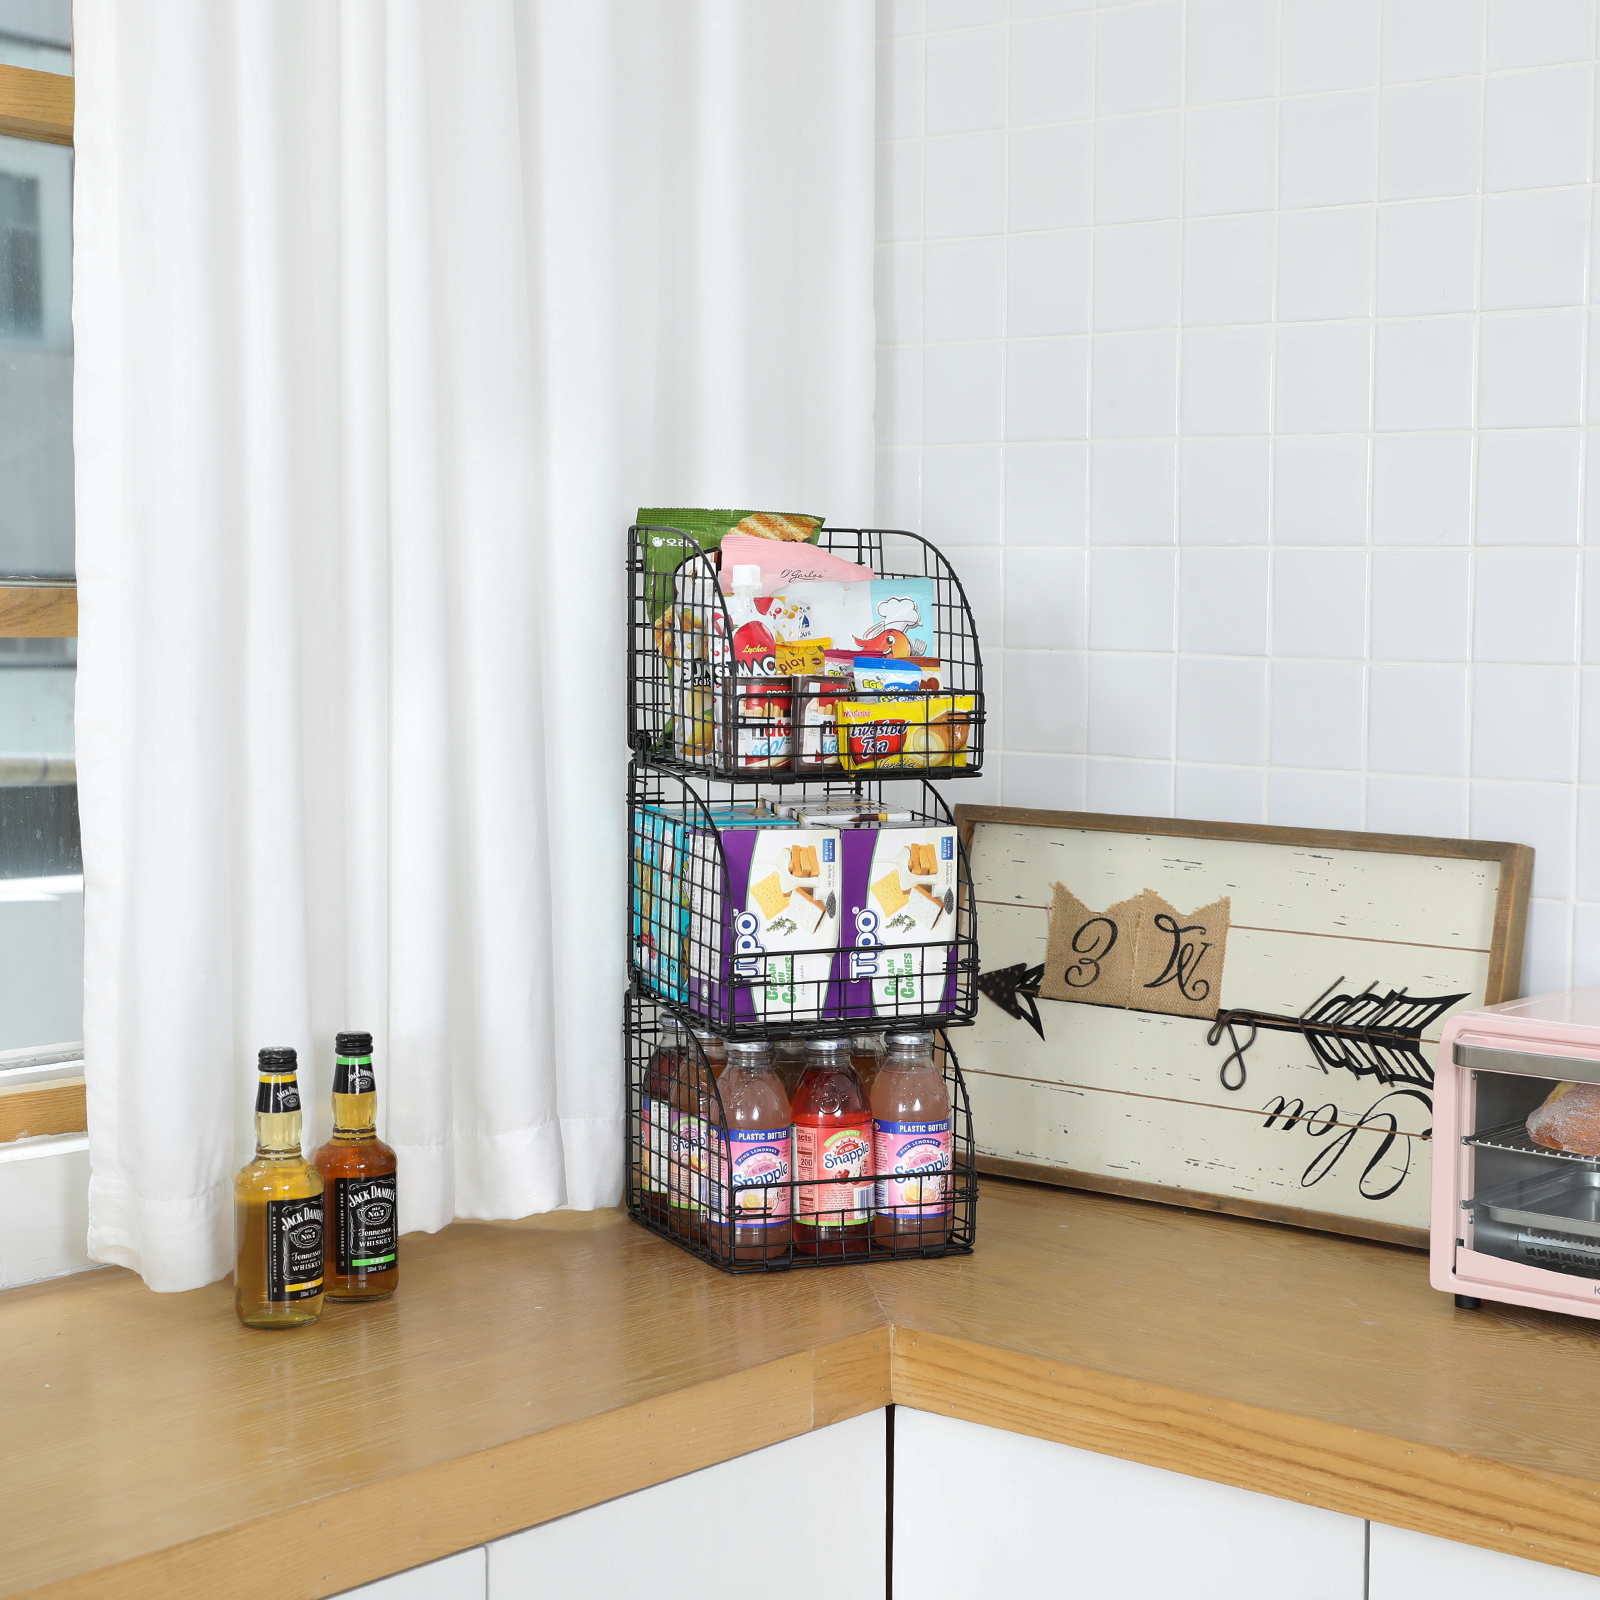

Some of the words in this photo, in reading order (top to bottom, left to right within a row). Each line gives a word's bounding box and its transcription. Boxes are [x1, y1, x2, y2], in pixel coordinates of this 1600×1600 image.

[742, 643, 768, 654] Lychee
[779, 656, 805, 676] play
[849, 908, 886, 984] Tipo
[765, 963, 778, 1001] CREAM
[884, 959, 897, 996] CREAM
[900, 952, 915, 999] COOKIES
[738, 1132, 766, 1141] PLASTIC
[767, 1130, 787, 1140] BOTTLE!
[899, 1125, 926, 1133] PLASTIC
[928, 1122, 948, 1132] BOTTLE!
[911, 1139, 939, 1147] LEMONADE
[800, 1157, 813, 1167] 200
[824, 1141, 870, 1169] Snapple
[732, 1160, 788, 1193] Snapple
[894, 1152, 950, 1184] Snapple
[348, 1189, 371, 1208] JACK
[281, 1211, 304, 1231] JACK
[358, 1226, 392, 1237] Tennessee
[359, 1237, 392, 1247] WHISKEY
[292, 1260, 322, 1272] WHISKEY
